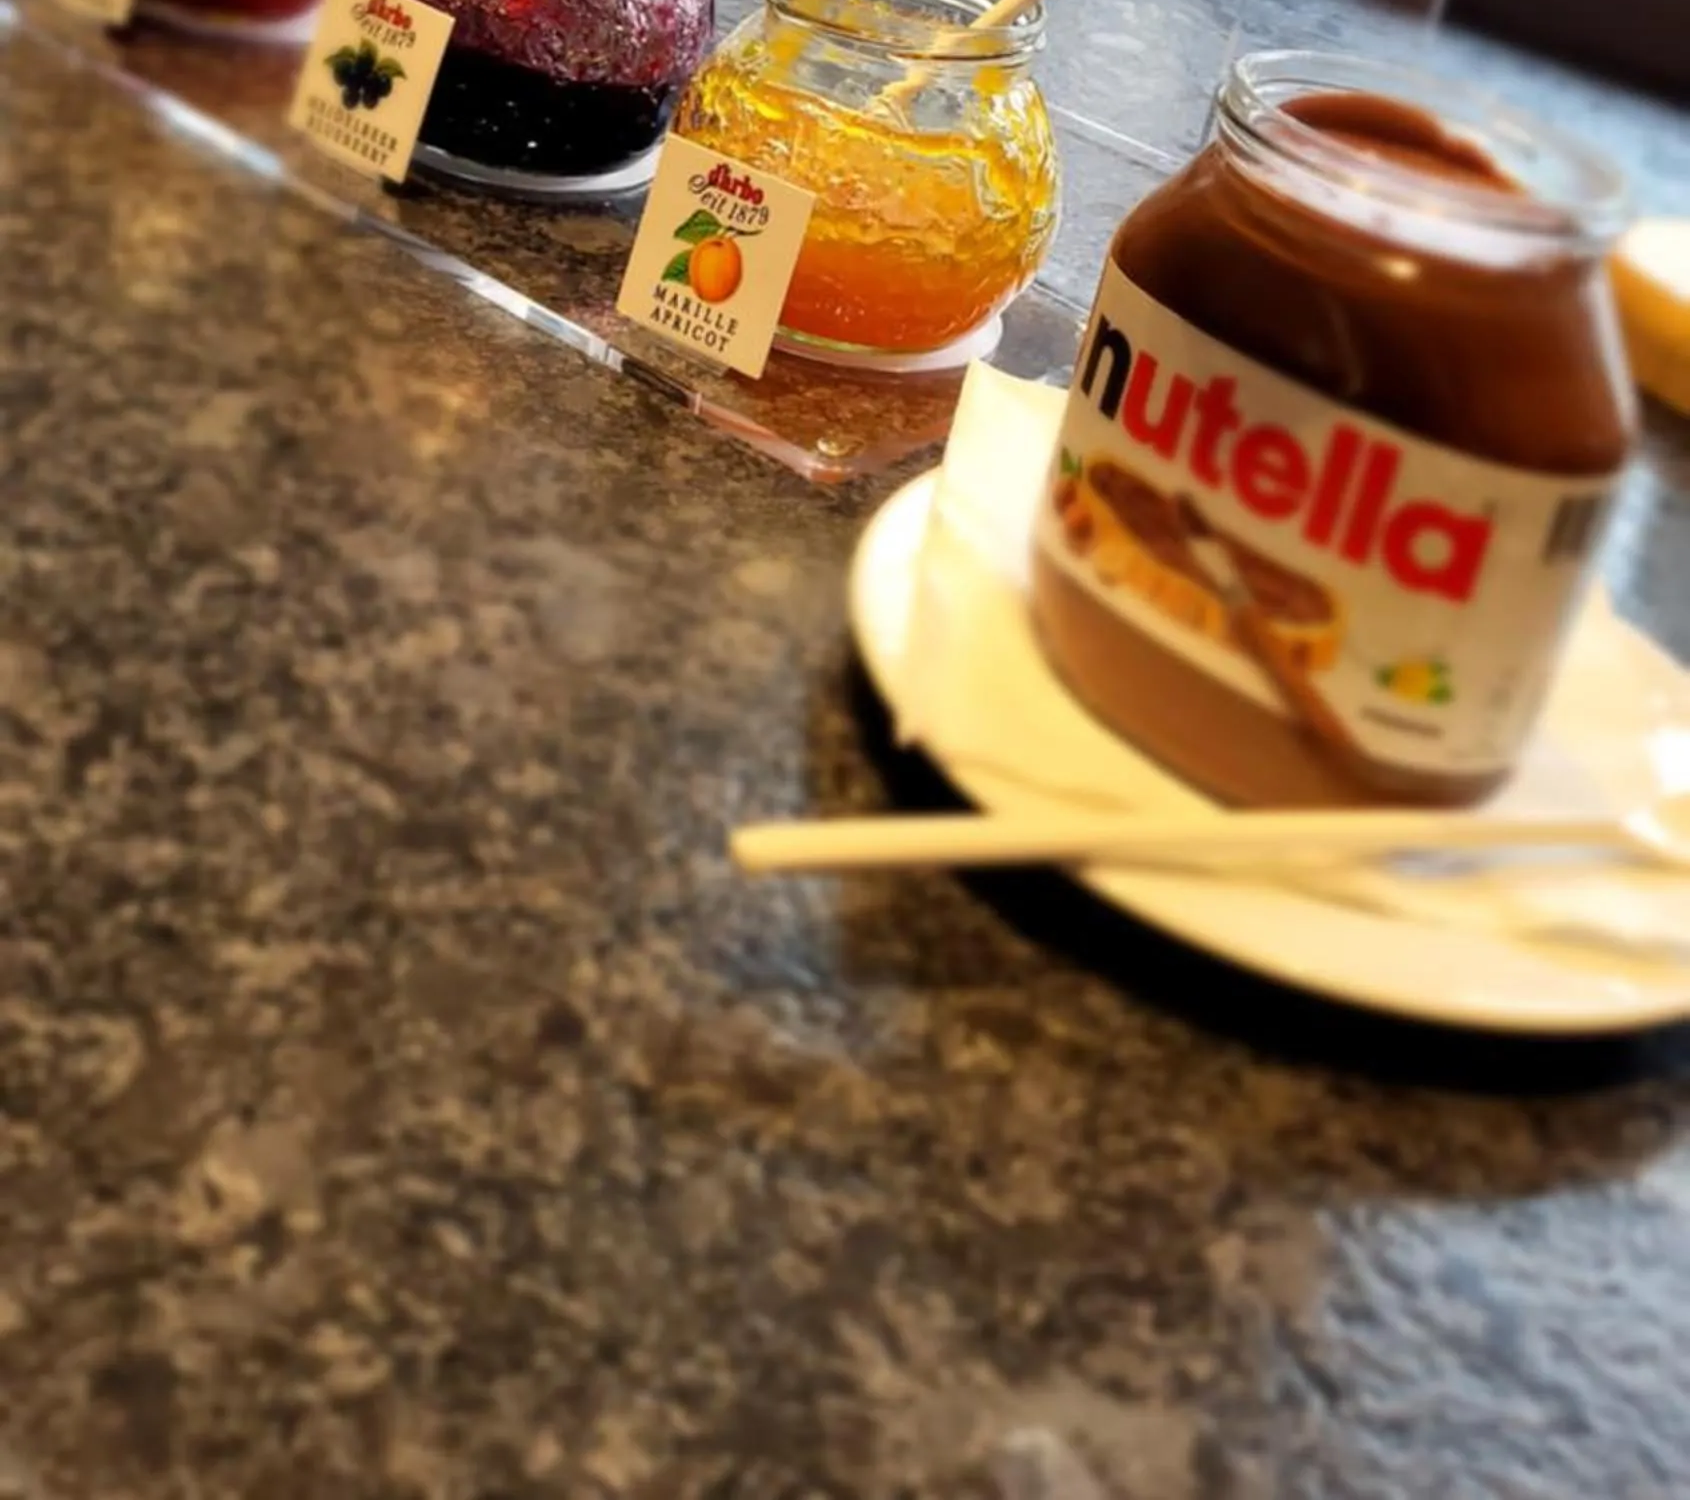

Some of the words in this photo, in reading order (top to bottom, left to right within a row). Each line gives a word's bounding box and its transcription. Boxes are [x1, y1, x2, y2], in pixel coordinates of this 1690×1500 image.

[688, 174, 727, 215] Seit
[728, 202, 770, 227] 1879
[651, 306, 731, 352] APRICOT
[653, 285, 739, 336] MARILLE
[1080, 312, 1495, 608] nutella
